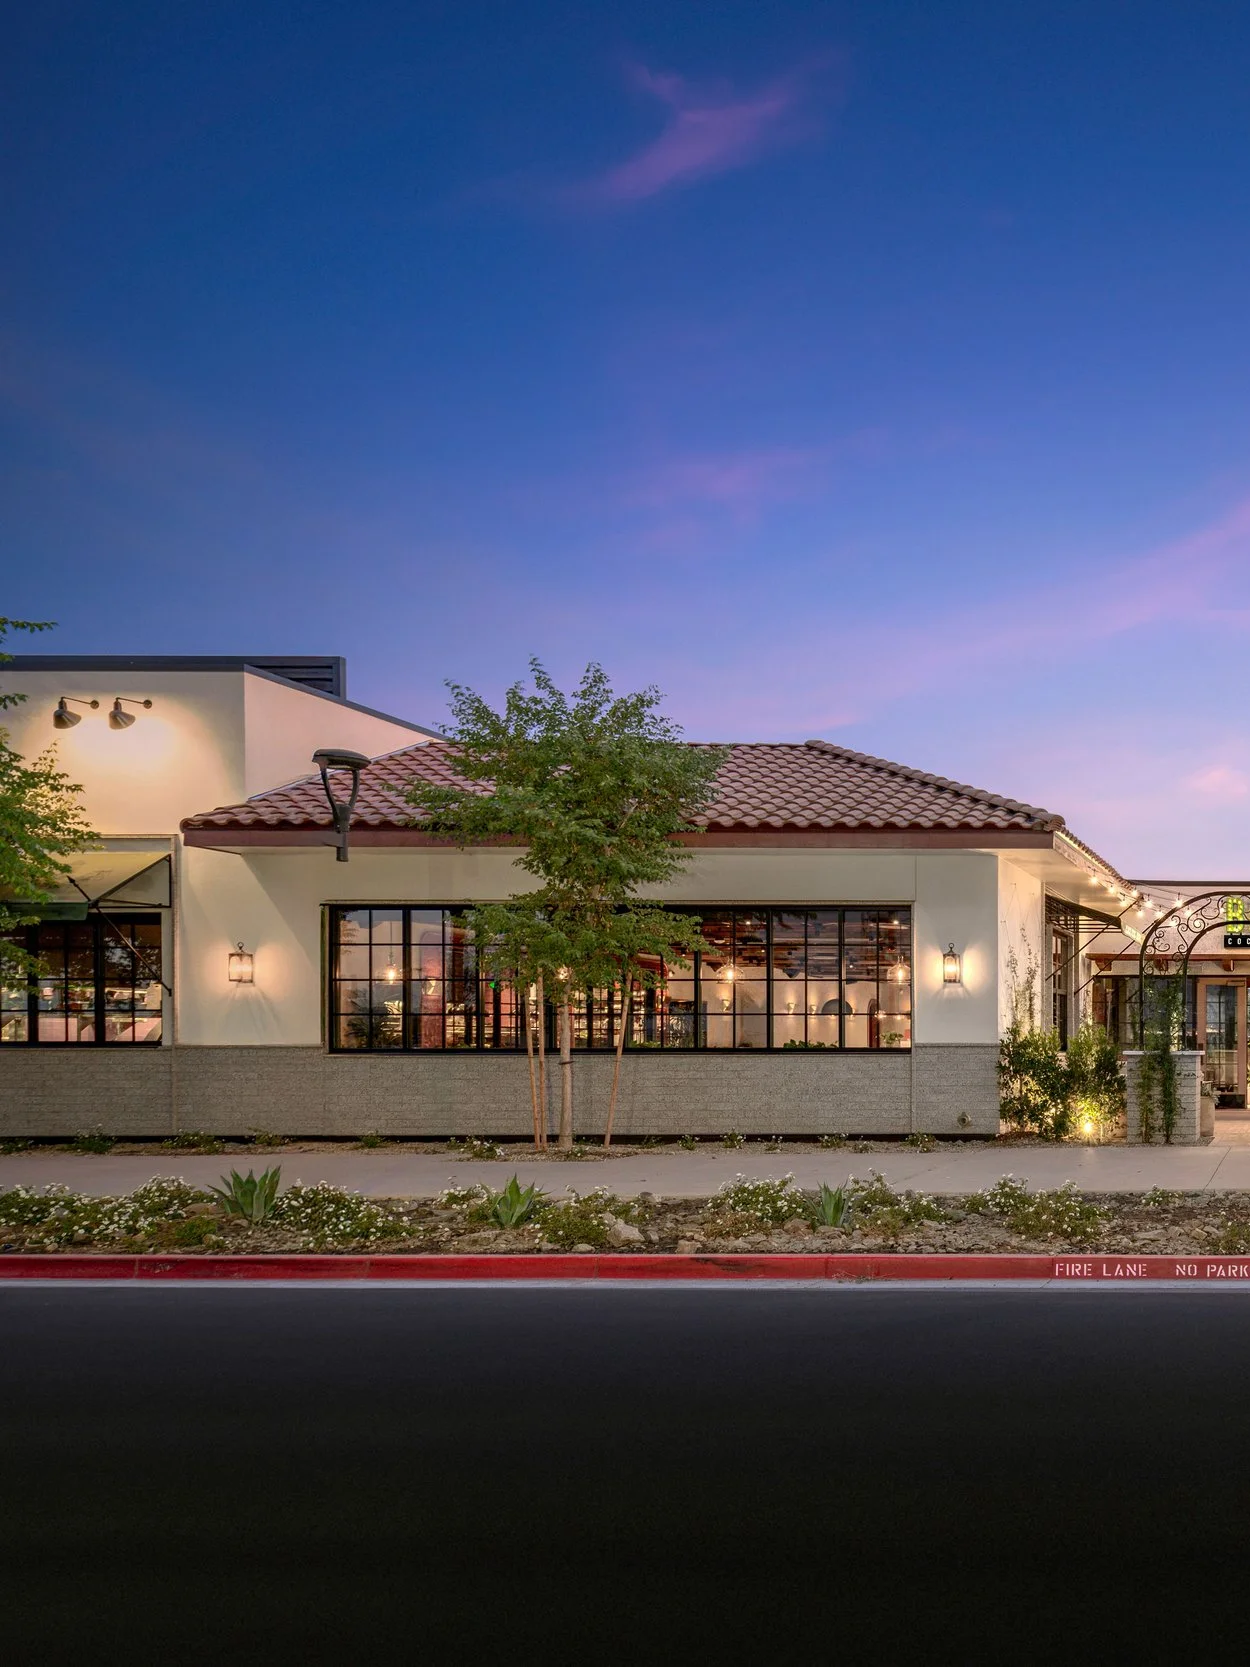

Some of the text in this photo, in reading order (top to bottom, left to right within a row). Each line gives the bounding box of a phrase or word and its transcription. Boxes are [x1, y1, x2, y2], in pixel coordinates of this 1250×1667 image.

[1055, 1263, 1093, 1276] FIRE
[1102, 1263, 1148, 1277] LANE
[1175, 1264, 1198, 1277] NO
